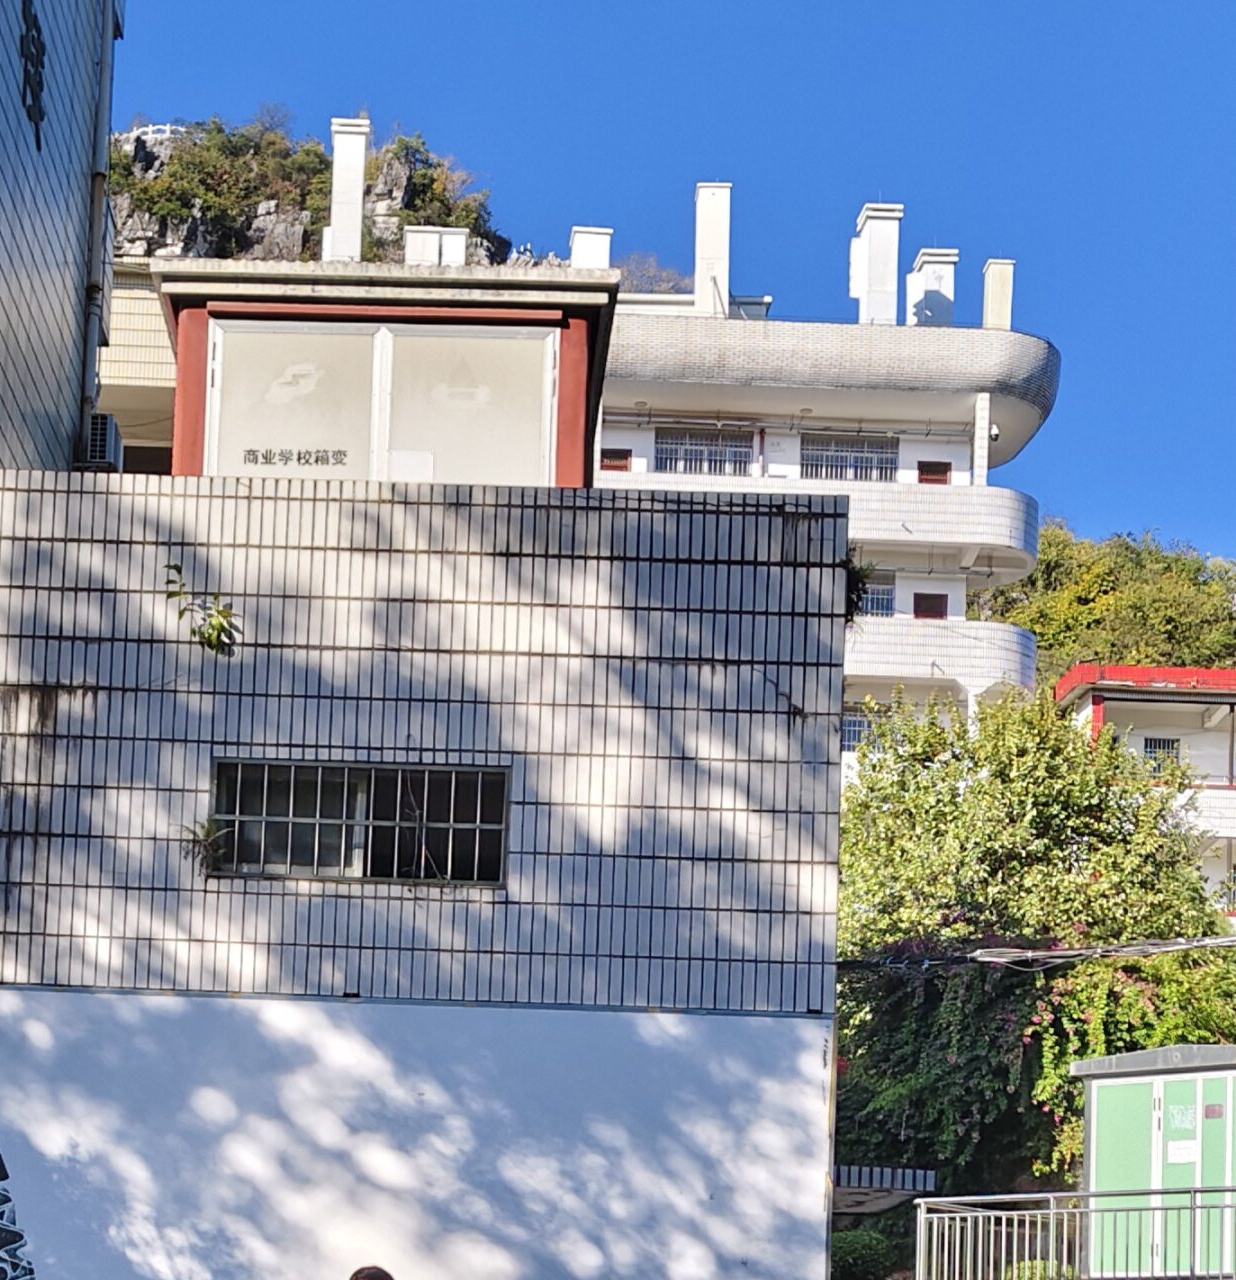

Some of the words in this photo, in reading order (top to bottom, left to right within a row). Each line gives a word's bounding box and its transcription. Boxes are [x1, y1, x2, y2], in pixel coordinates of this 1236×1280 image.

[243, 449, 348, 466] 商业学校箱变
